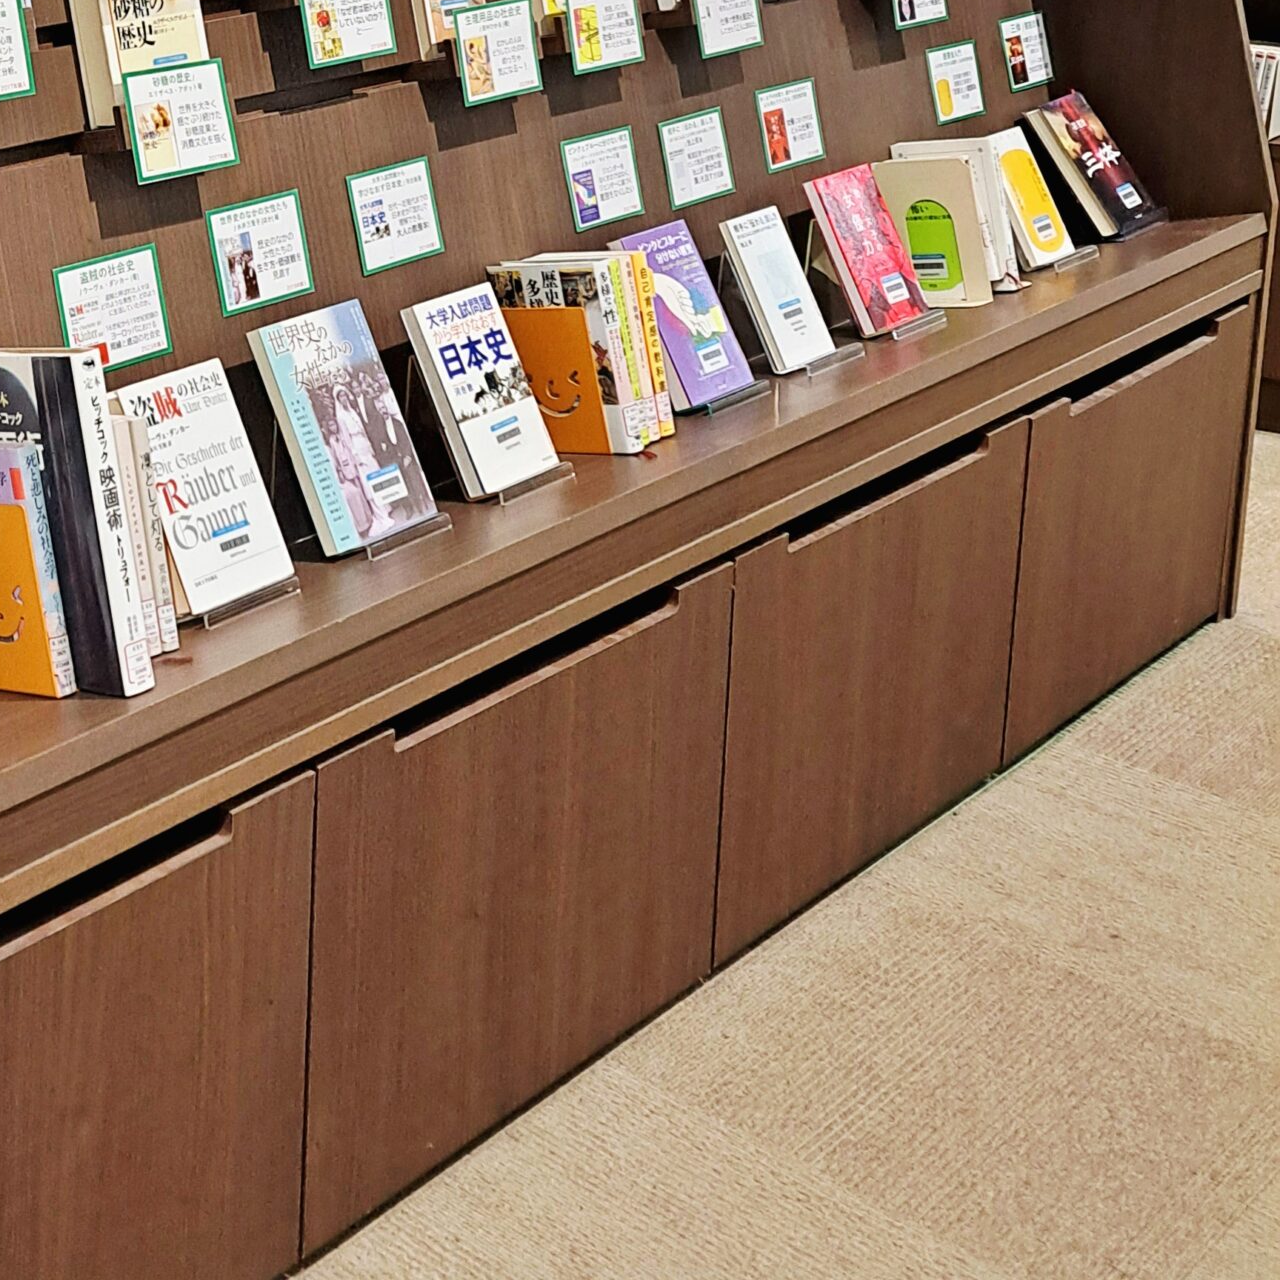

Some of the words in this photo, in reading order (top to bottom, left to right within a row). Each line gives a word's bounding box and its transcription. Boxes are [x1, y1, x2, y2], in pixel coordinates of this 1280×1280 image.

[117, 22, 156, 51] 歴史
[79, 259, 136, 285] 盗賊の社会史
[540, 270, 562, 308] 歴史
[425, 293, 494, 330] 大学入試問題
[432, 311, 498, 345] から学びなおす
[268, 320, 328, 357] 世界史の
[314, 340, 353, 365] なかの
[438, 327, 513, 381] 日本史
[291, 362, 350, 393] 女性たち
[90, 395, 108, 464] ヒッチコック
[175, 440, 229, 470] Geschichte
[229, 434, 245, 450] der
[98, 465, 123, 532] 映画術
[156, 464, 238, 515] Räuber
[240, 470, 257, 486] und
[173, 499, 249, 551] Gauner
[115, 535, 131, 603] トリュフォー
